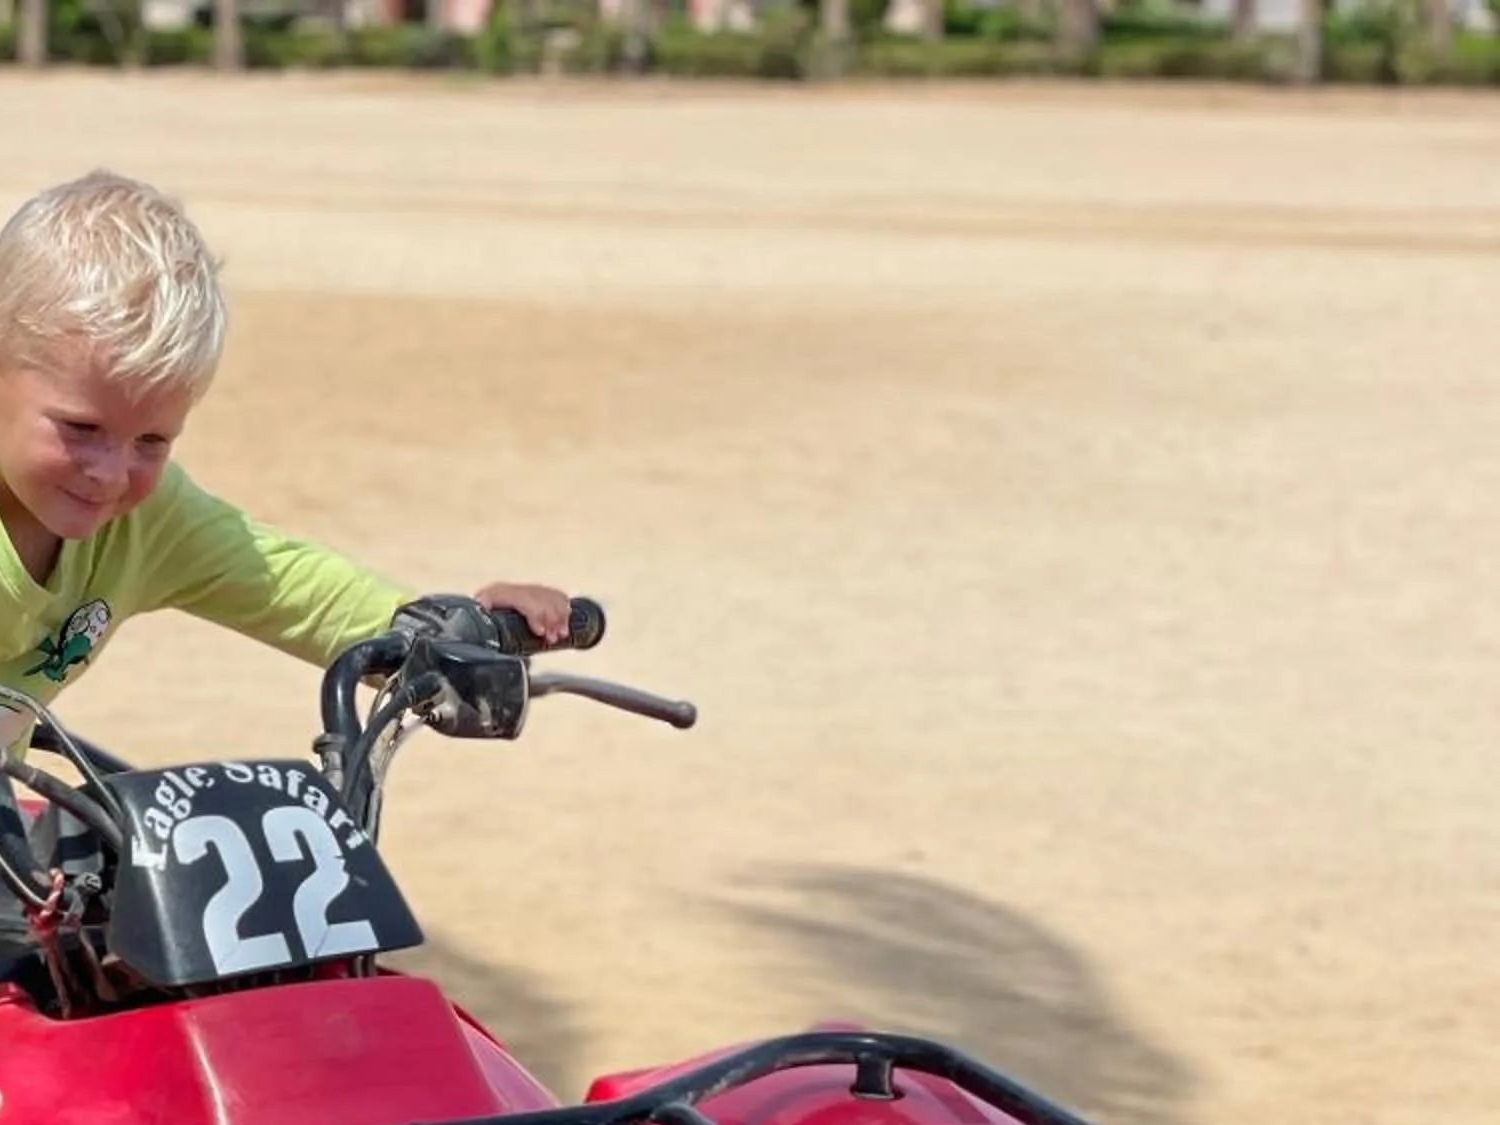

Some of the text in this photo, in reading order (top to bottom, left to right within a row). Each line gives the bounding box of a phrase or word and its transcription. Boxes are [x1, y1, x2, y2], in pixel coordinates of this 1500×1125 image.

[131, 761, 369, 871] Eagle Safari
[172, 805, 380, 976] 22
